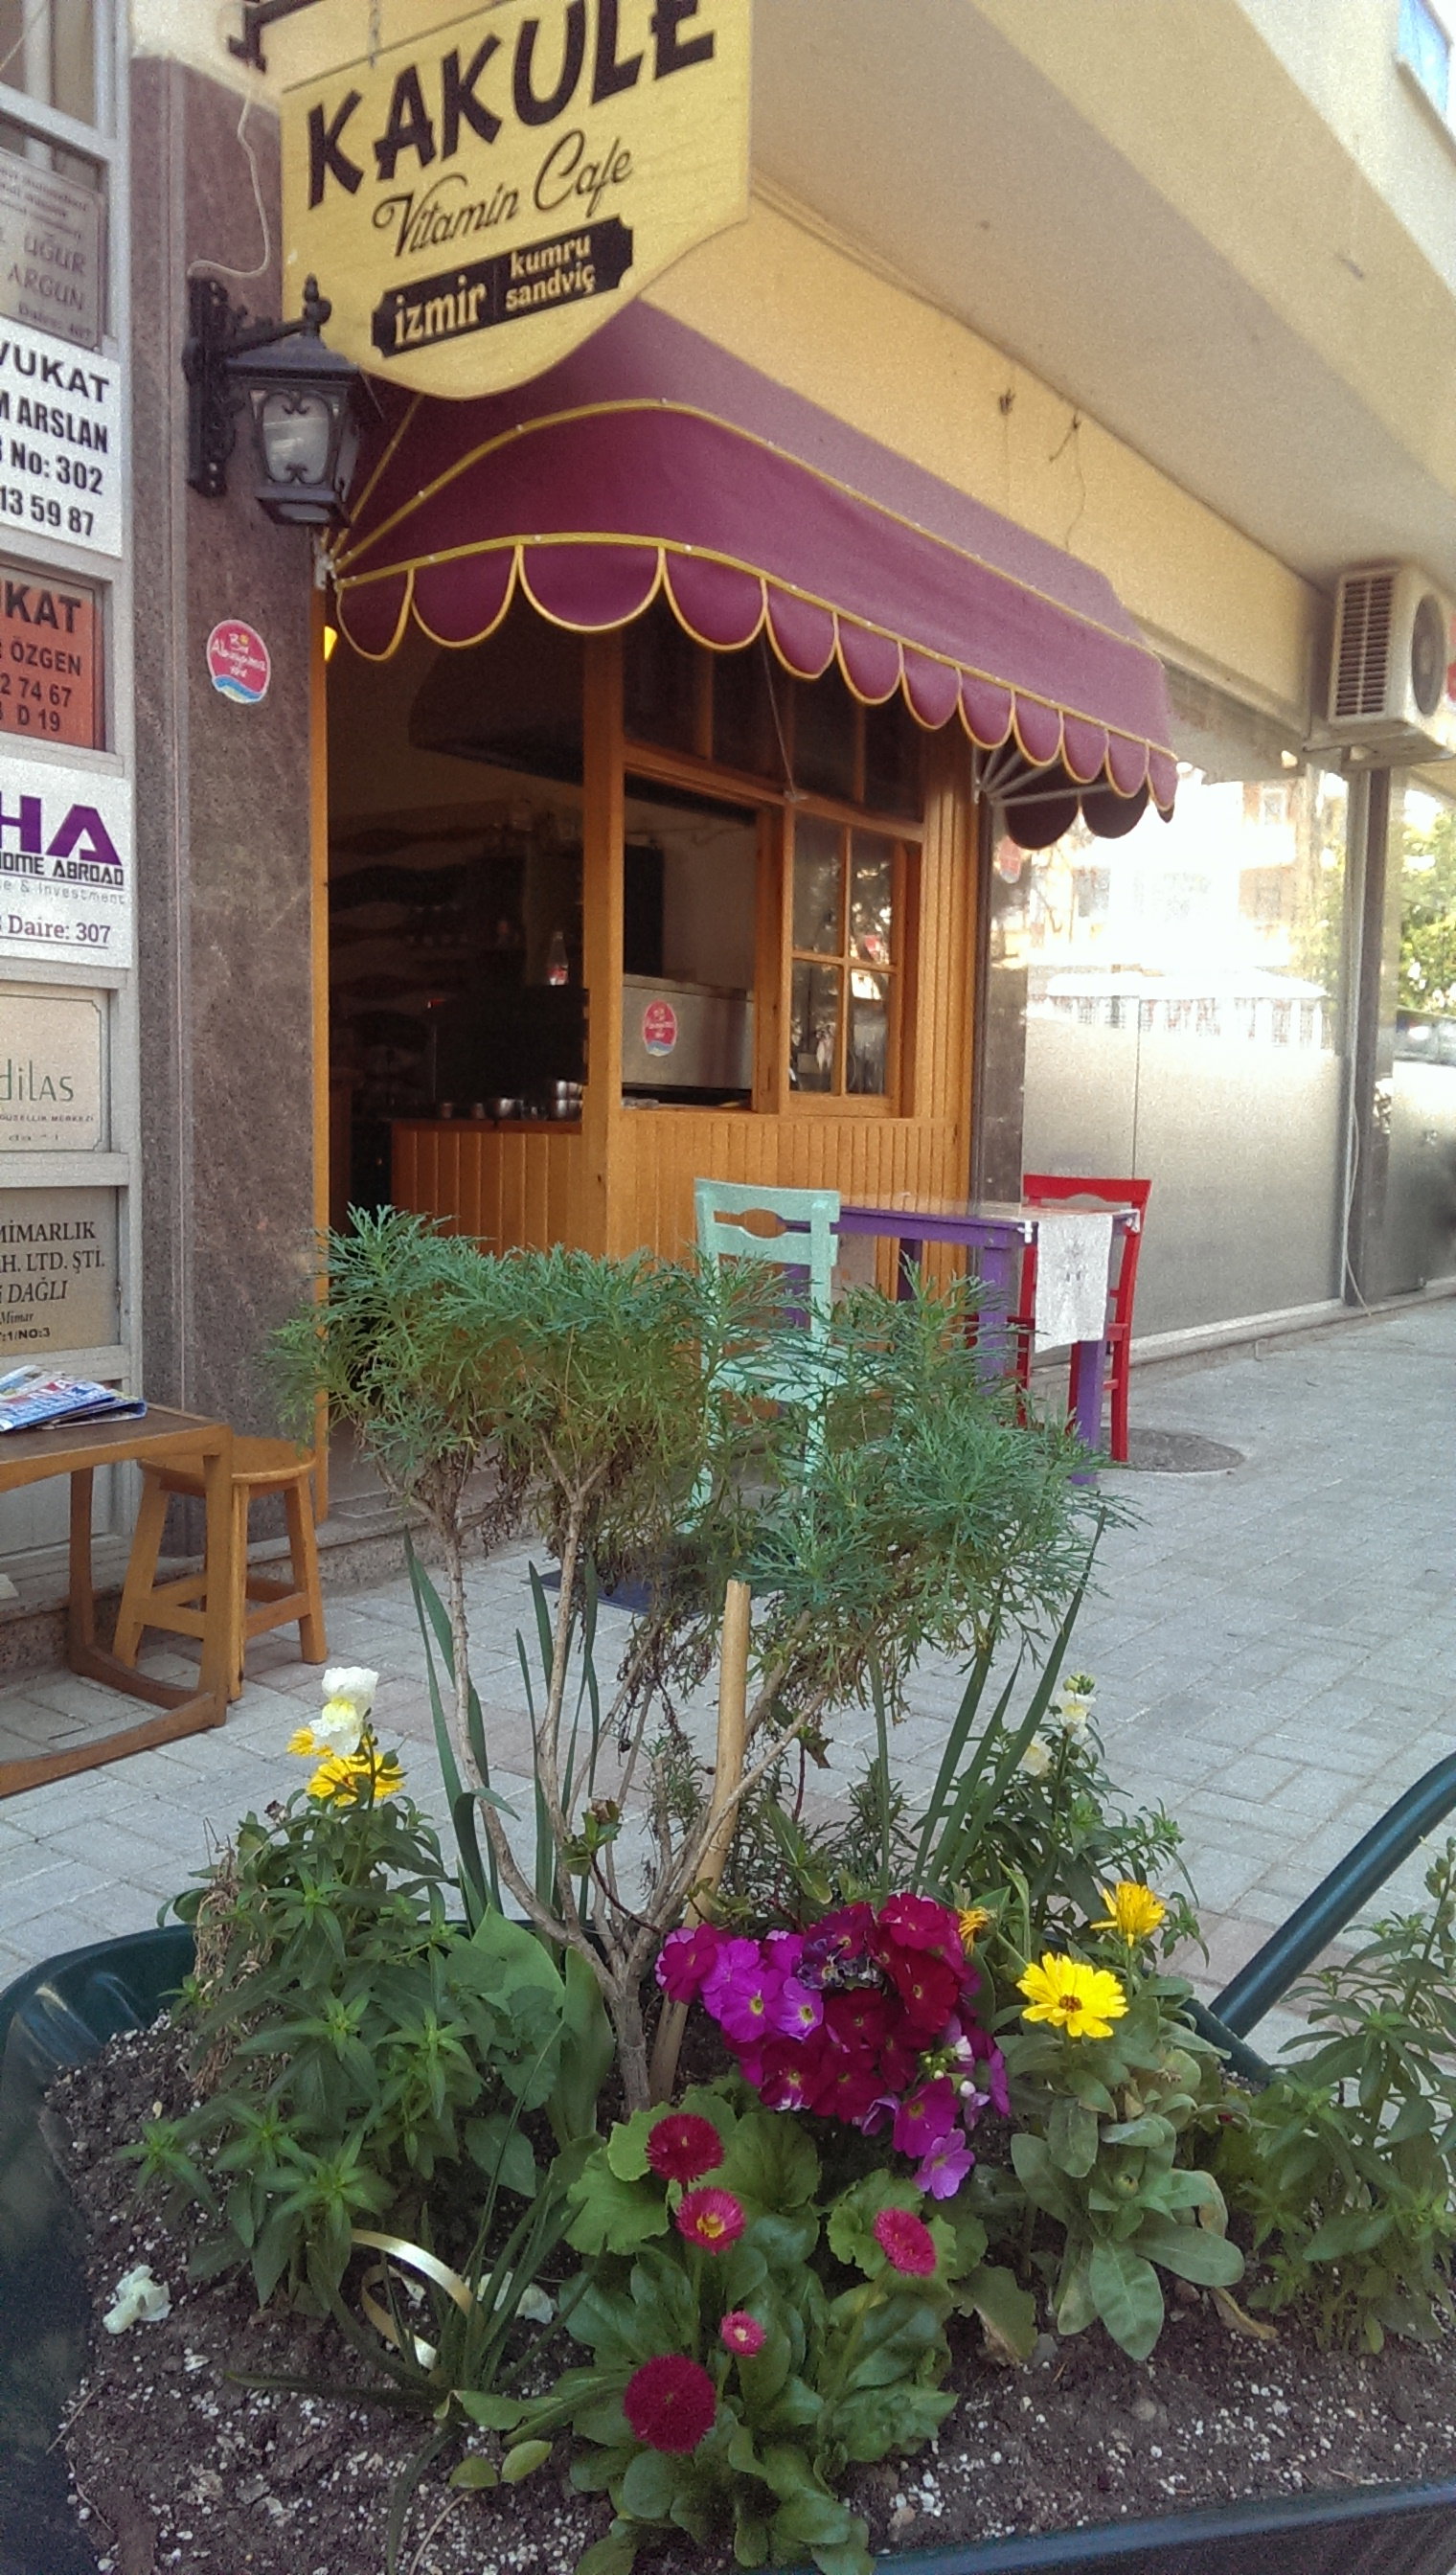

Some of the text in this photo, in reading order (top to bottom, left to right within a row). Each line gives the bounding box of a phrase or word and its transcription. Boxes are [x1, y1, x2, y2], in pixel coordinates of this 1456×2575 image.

[307, 0, 716, 211] KAKULE
[373, 129, 634, 258] Vitamin Cafe
[510, 234, 592, 280] kumru
[505, 261, 596, 311] sandviç
[394, 274, 487, 346] izmir
[17, 396, 108, 453] ARSLAN
[11, 439, 50, 478] No:
[56, 454, 103, 496] 302
[31, 493, 61, 527] 59
[68, 506, 94, 536] 87
[11, 635, 81, 676] ÖZGEN
[18, 675, 42, 702] 74
[49, 683, 73, 708] 67
[17, 704, 60, 732] D 19
[52, 859, 125, 886] ABROAD
[8, 914, 111, 945] Daire: 307
[26, 1250, 68, 1272] LTD.
[72, 1245, 105, 1274] ŞTİ.
[8, 1276, 68, 1304] DAĞLI
